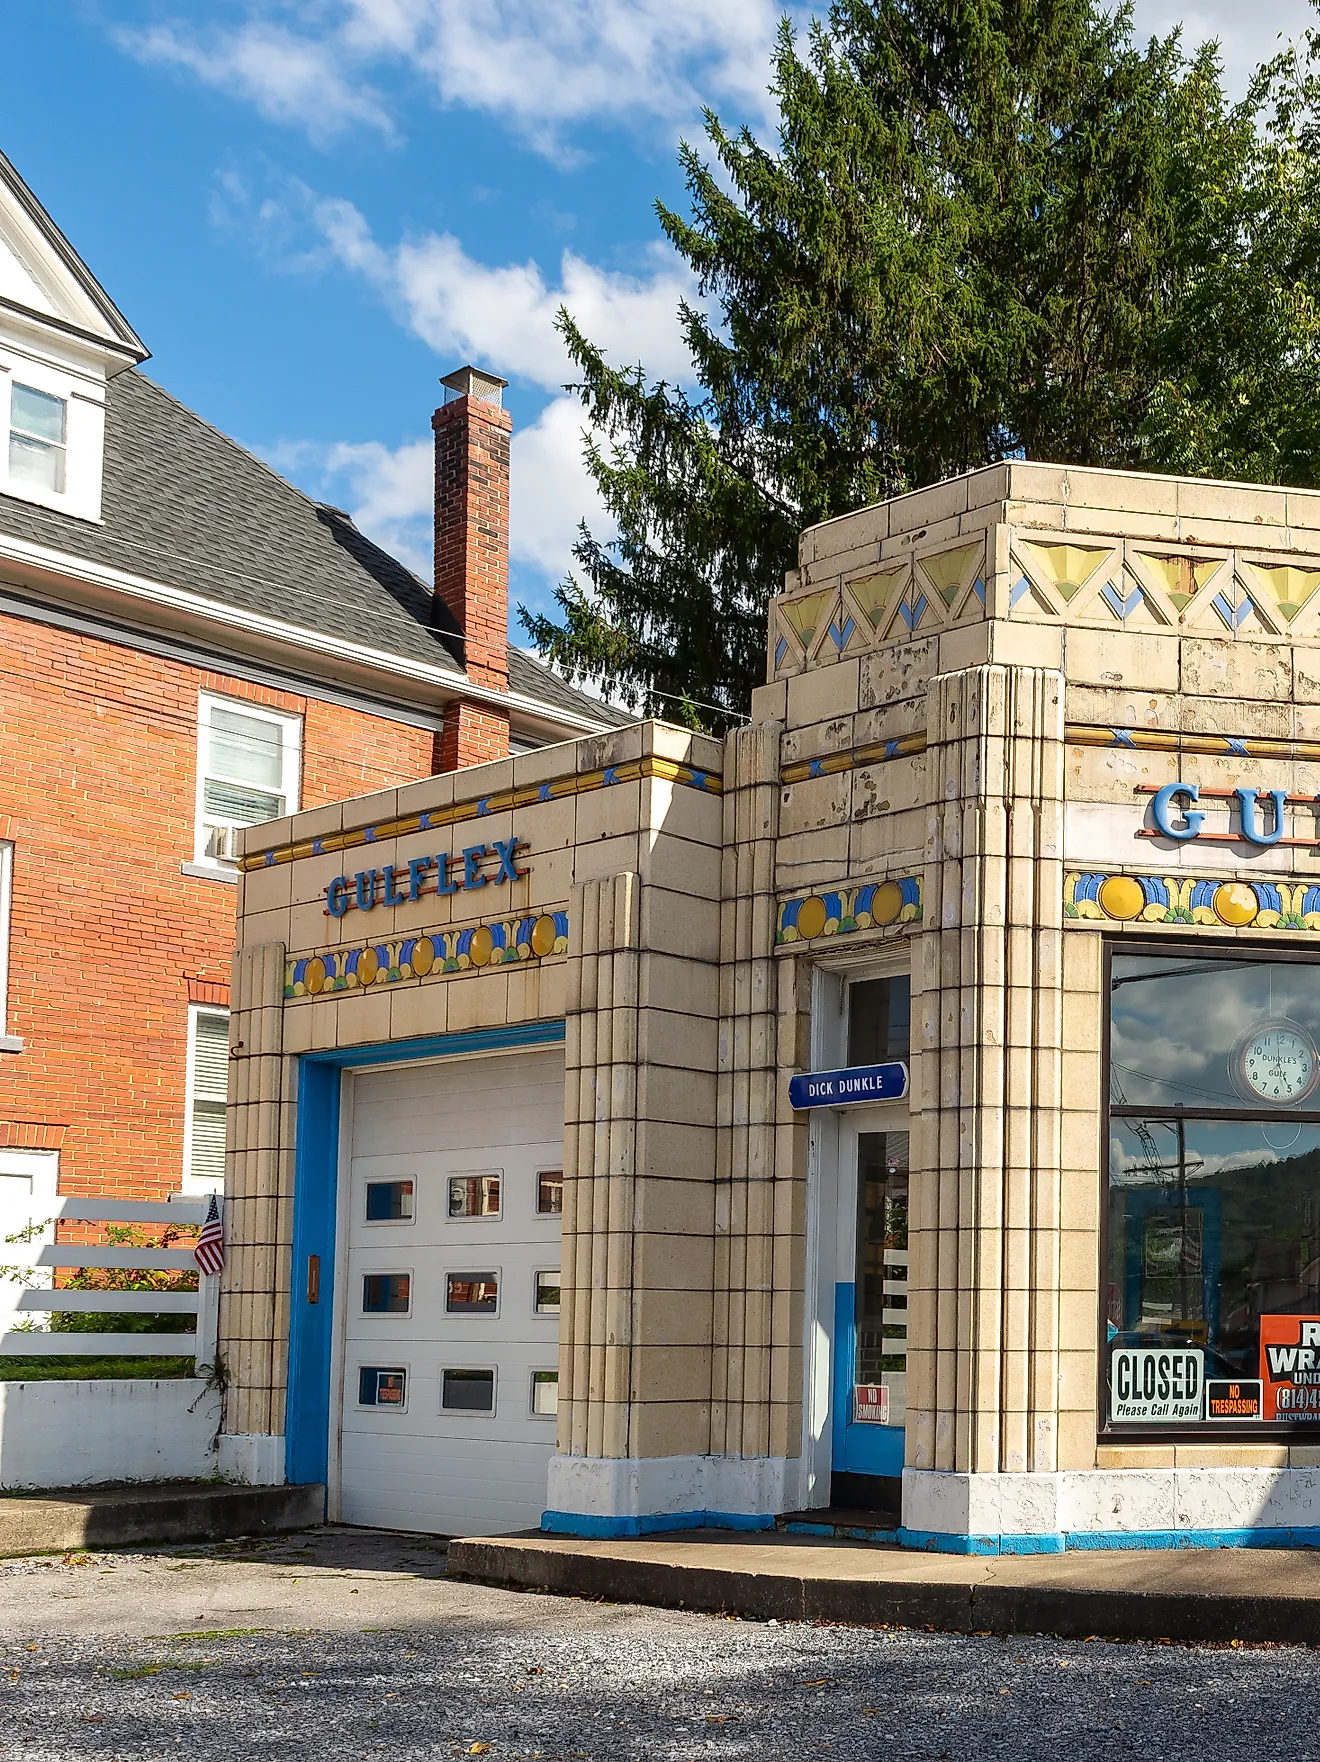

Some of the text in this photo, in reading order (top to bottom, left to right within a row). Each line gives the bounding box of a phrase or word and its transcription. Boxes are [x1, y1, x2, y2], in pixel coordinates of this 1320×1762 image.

[326, 836, 519, 918] GULFLEX
[1264, 1038, 1270, 1046] 11
[1254, 1046, 1262, 1055] 10
[1298, 1050, 1304, 1058] 2
[1249, 1059, 1254, 1067] 9
[1262, 1054, 1297, 1064] DUNKLE'S
[1302, 1064, 1308, 1072] 3
[1252, 1072, 1258, 1080] 8
[1296, 1076, 1302, 1084] 4
[808, 1076, 882, 1097] DICK DUNKLE
[1262, 1082, 1267, 1090] 7
[1274, 1086, 1279, 1094] 6
[1286, 1084, 1292, 1092] 5
[1118, 1355, 1198, 1400] CLOSED
[868, 1388, 878, 1403] NO
[1229, 1384, 1240, 1399] NO
[1117, 1404, 1198, 1418] Please Call Again
[1212, 1400, 1258, 1414] TRESPASSING
[858, 1404, 888, 1420] SMOKING
